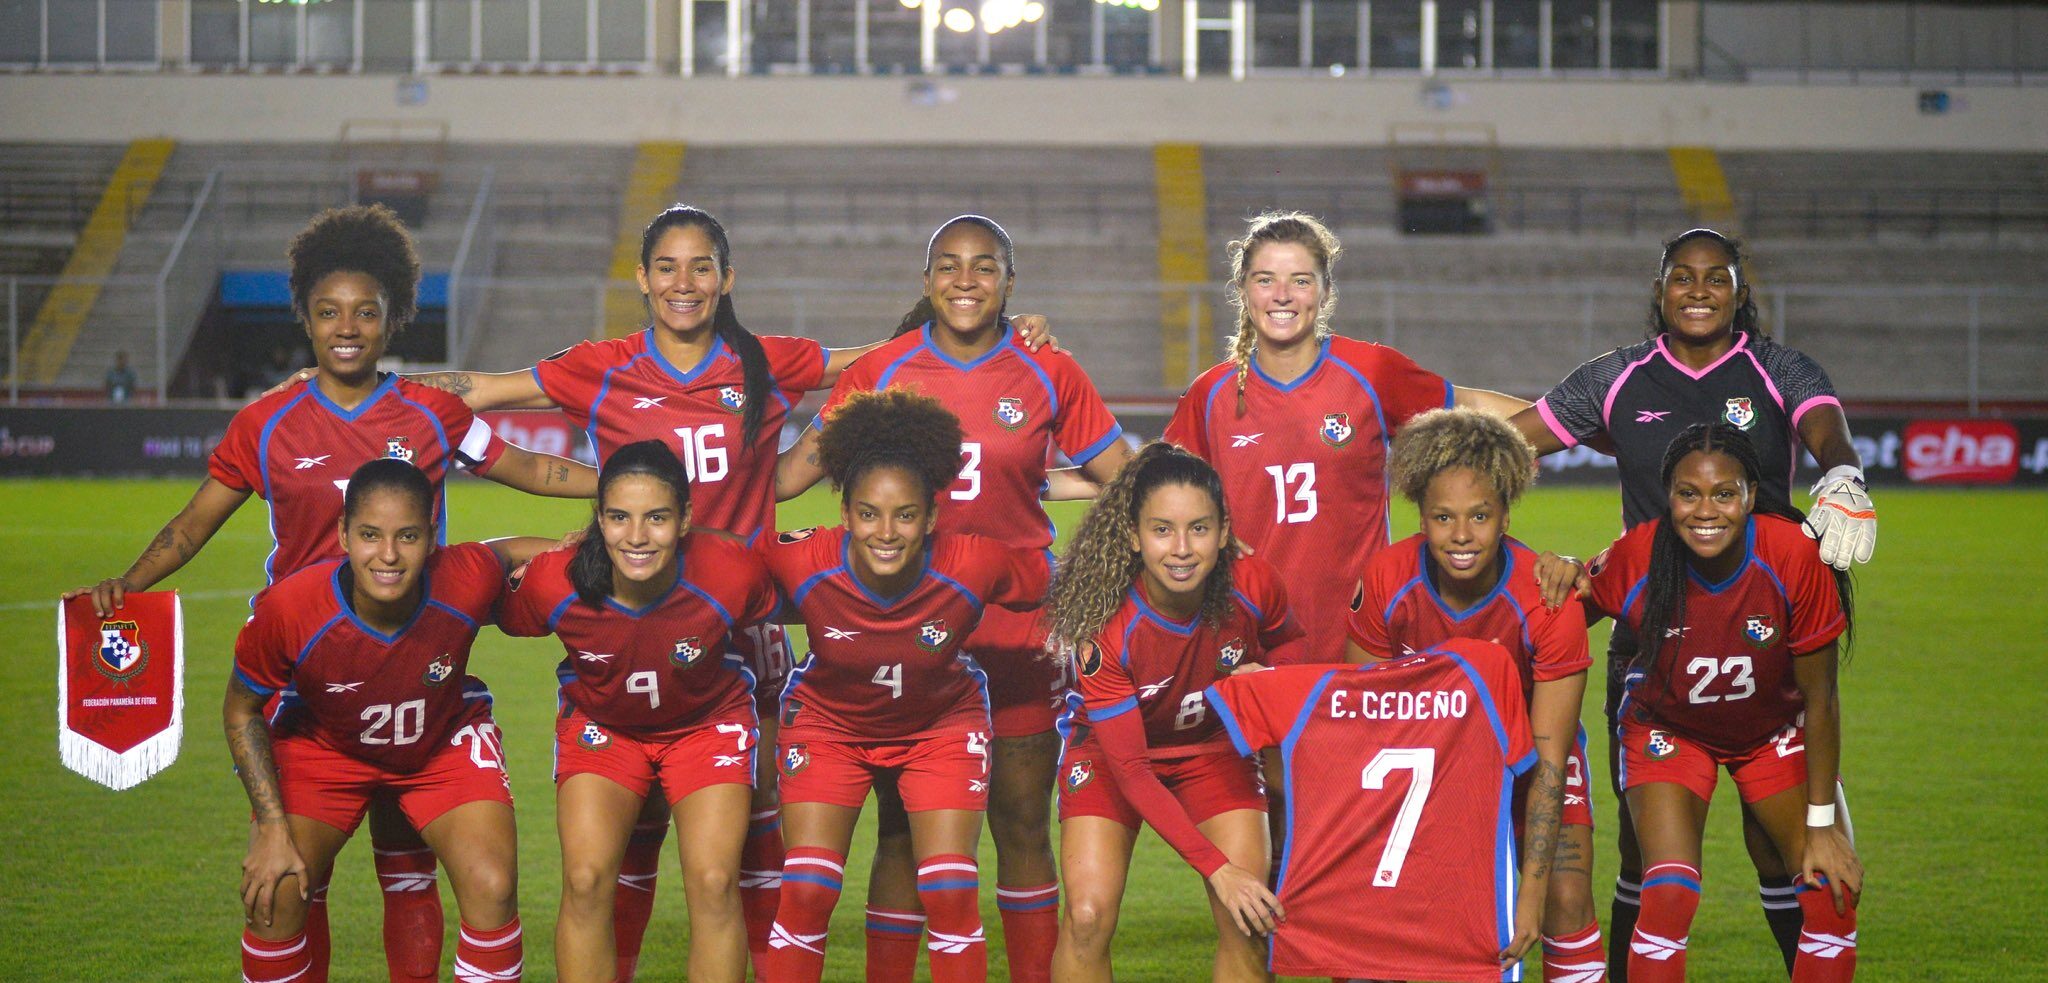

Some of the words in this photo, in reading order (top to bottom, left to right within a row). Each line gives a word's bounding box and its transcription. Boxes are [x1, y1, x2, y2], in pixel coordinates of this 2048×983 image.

[673, 423, 729, 483] 16
[950, 442, 982, 501] 3
[1264, 462, 1318, 524] 13
[625, 670, 661, 710] 9
[871, 663, 902, 699] 4
[1686, 655, 1757, 704] 23
[360, 698, 426, 746] 20
[1174, 690, 1206, 731] 8
[1331, 690, 1357, 718] E.
[1362, 690, 1467, 720] CEDEÑO
[1362, 748, 1435, 888] 7
